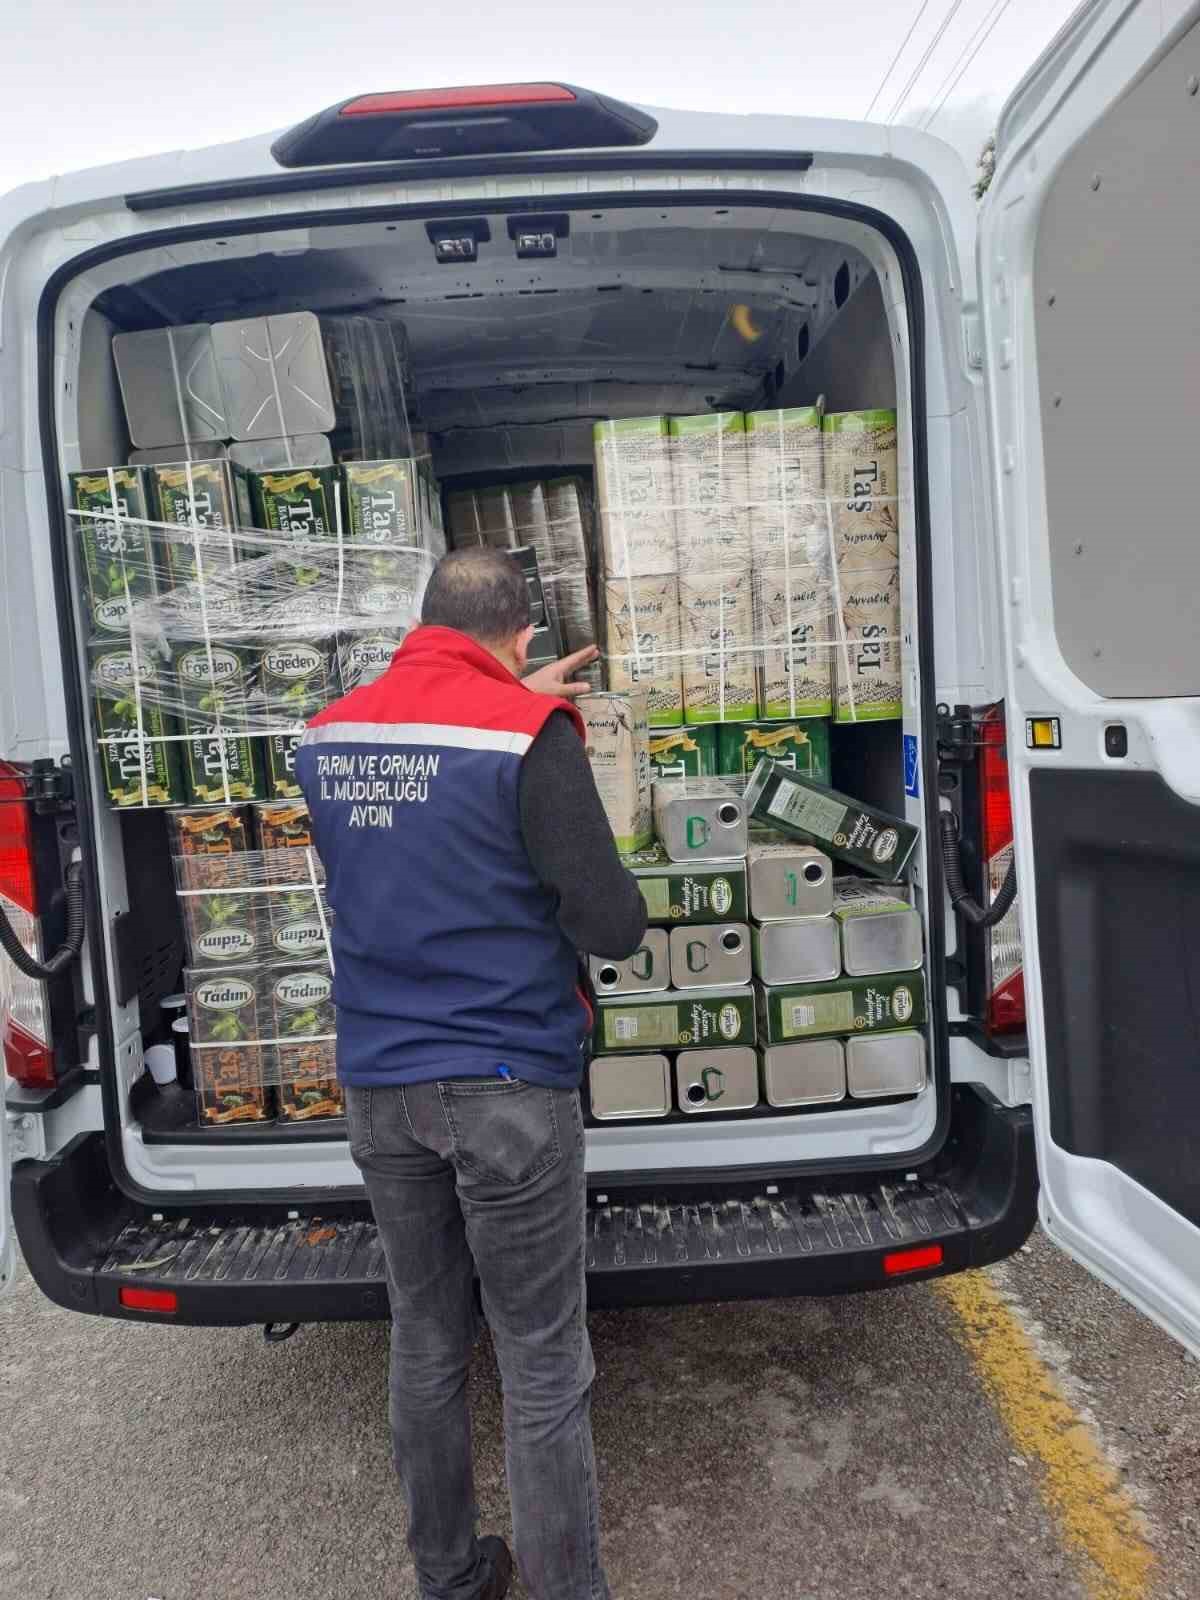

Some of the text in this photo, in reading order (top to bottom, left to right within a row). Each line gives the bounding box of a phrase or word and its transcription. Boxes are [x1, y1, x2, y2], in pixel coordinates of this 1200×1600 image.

[847, 460, 878, 512] Taş
[352, 648, 392, 666] Egede
[857, 624, 888, 675] Taş
[268, 654, 315, 674] Egeden
[317, 754, 440, 776] TARIM VE ORMAN
[321, 775, 429, 802] İL MÜDÜRLÜĞÜ
[348, 805, 393, 828] AYDIN
[201, 988, 249, 1003] Tadım
[279, 983, 328, 999] Tadım
